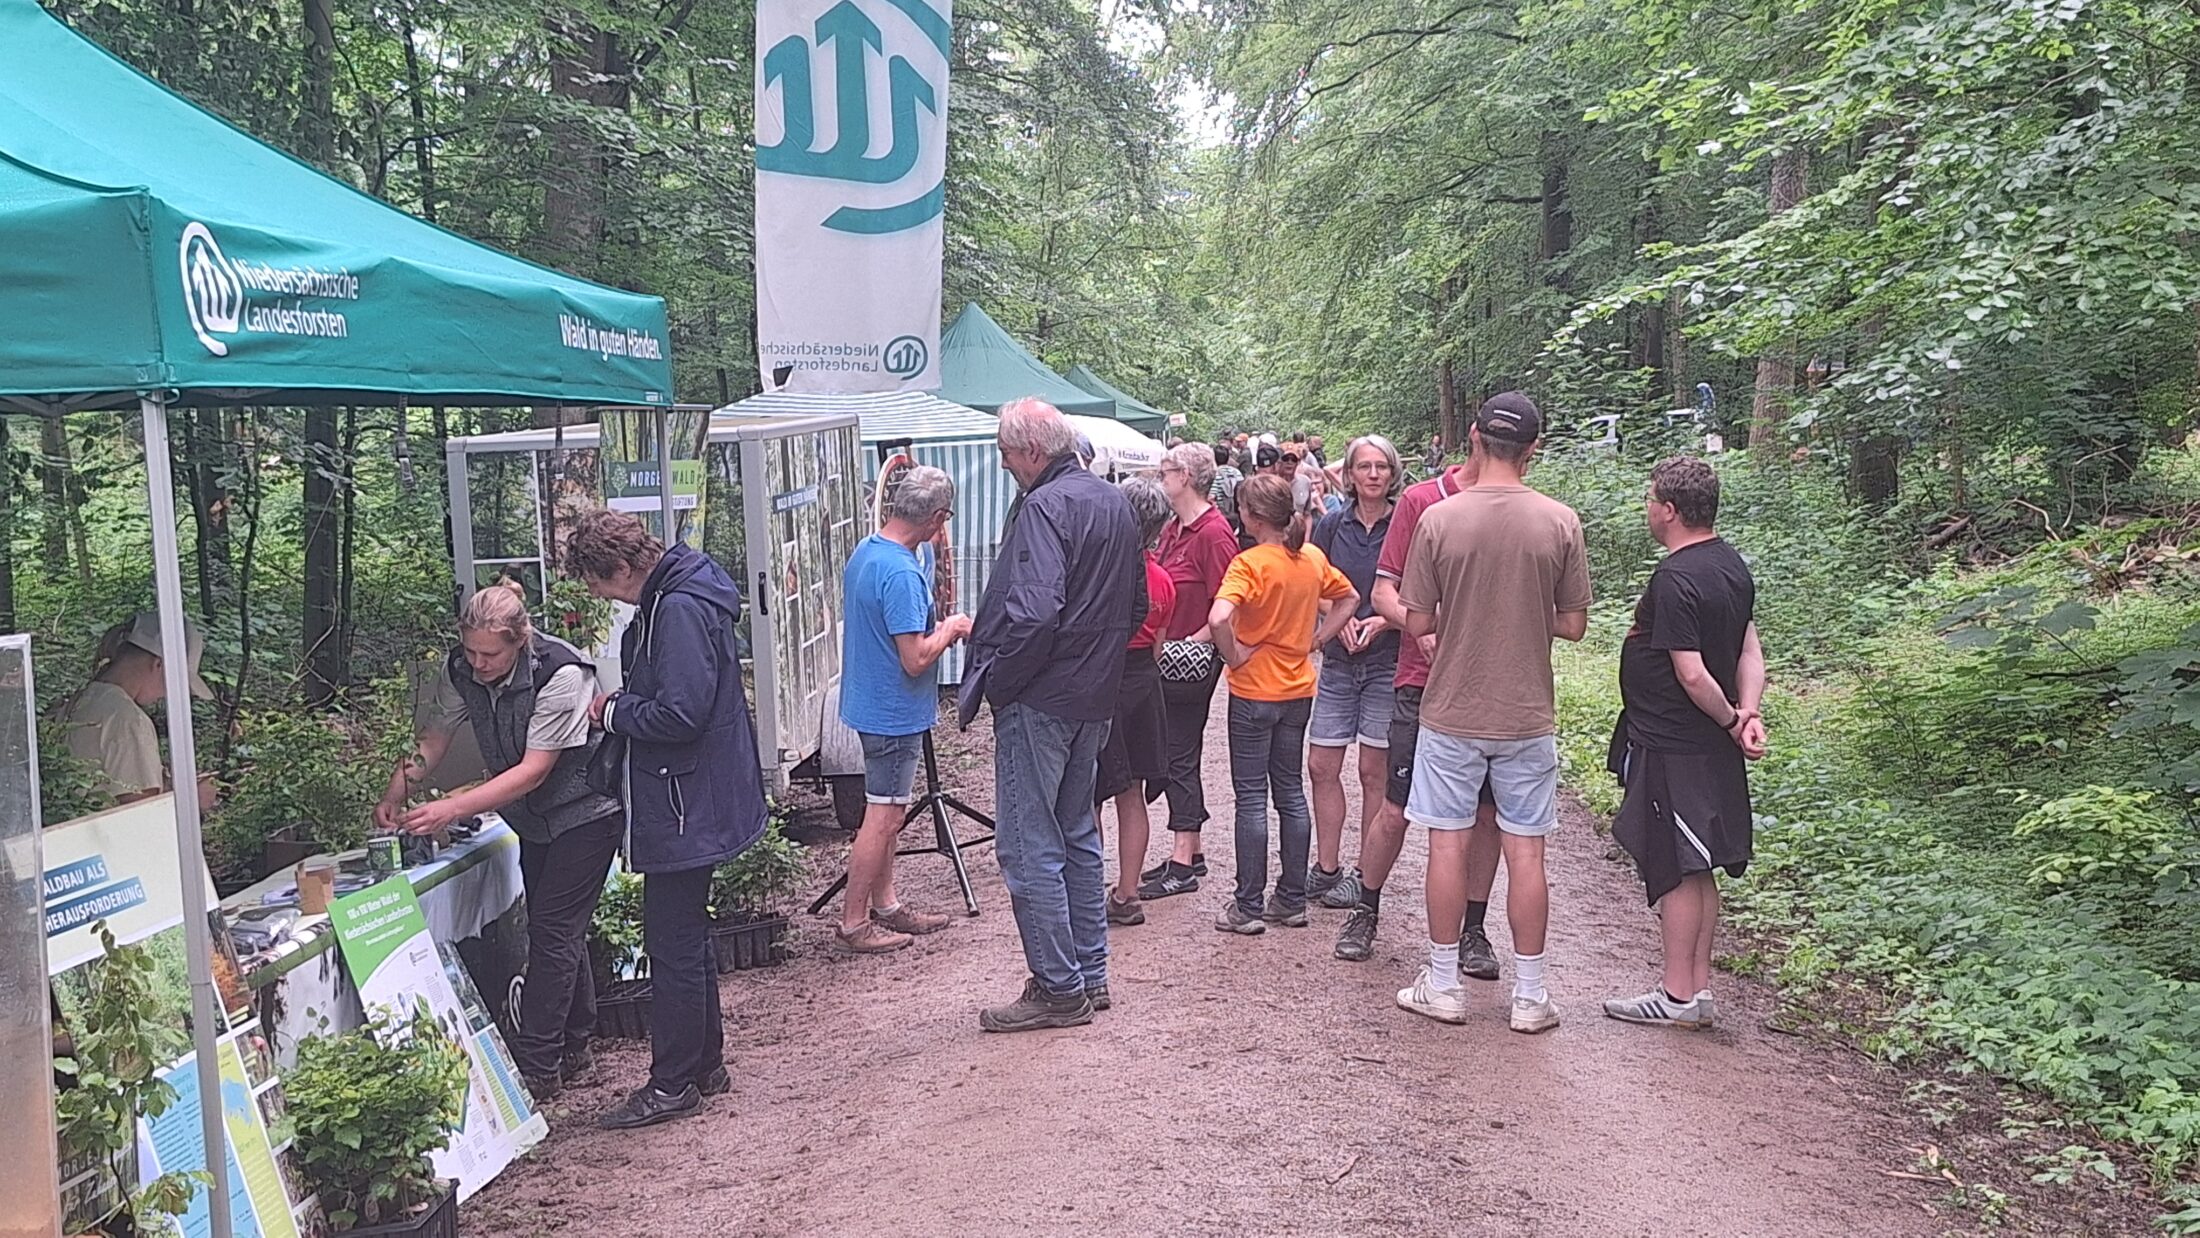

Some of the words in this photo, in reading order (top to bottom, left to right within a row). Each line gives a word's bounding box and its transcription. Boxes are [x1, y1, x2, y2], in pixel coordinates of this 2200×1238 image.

[231, 257, 359, 300] Niedersächsische
[244, 298, 348, 337] Landesforsten
[559, 313, 587, 350] Wald
[587, 319, 599, 352] in
[599, 327, 627, 362] guten
[627, 327, 663, 360] Händen.
[43, 868, 85, 897] ALDBAU
[86, 861, 106, 881] ALS
[45, 883, 144, 933] HERAUSFORDERUNG
